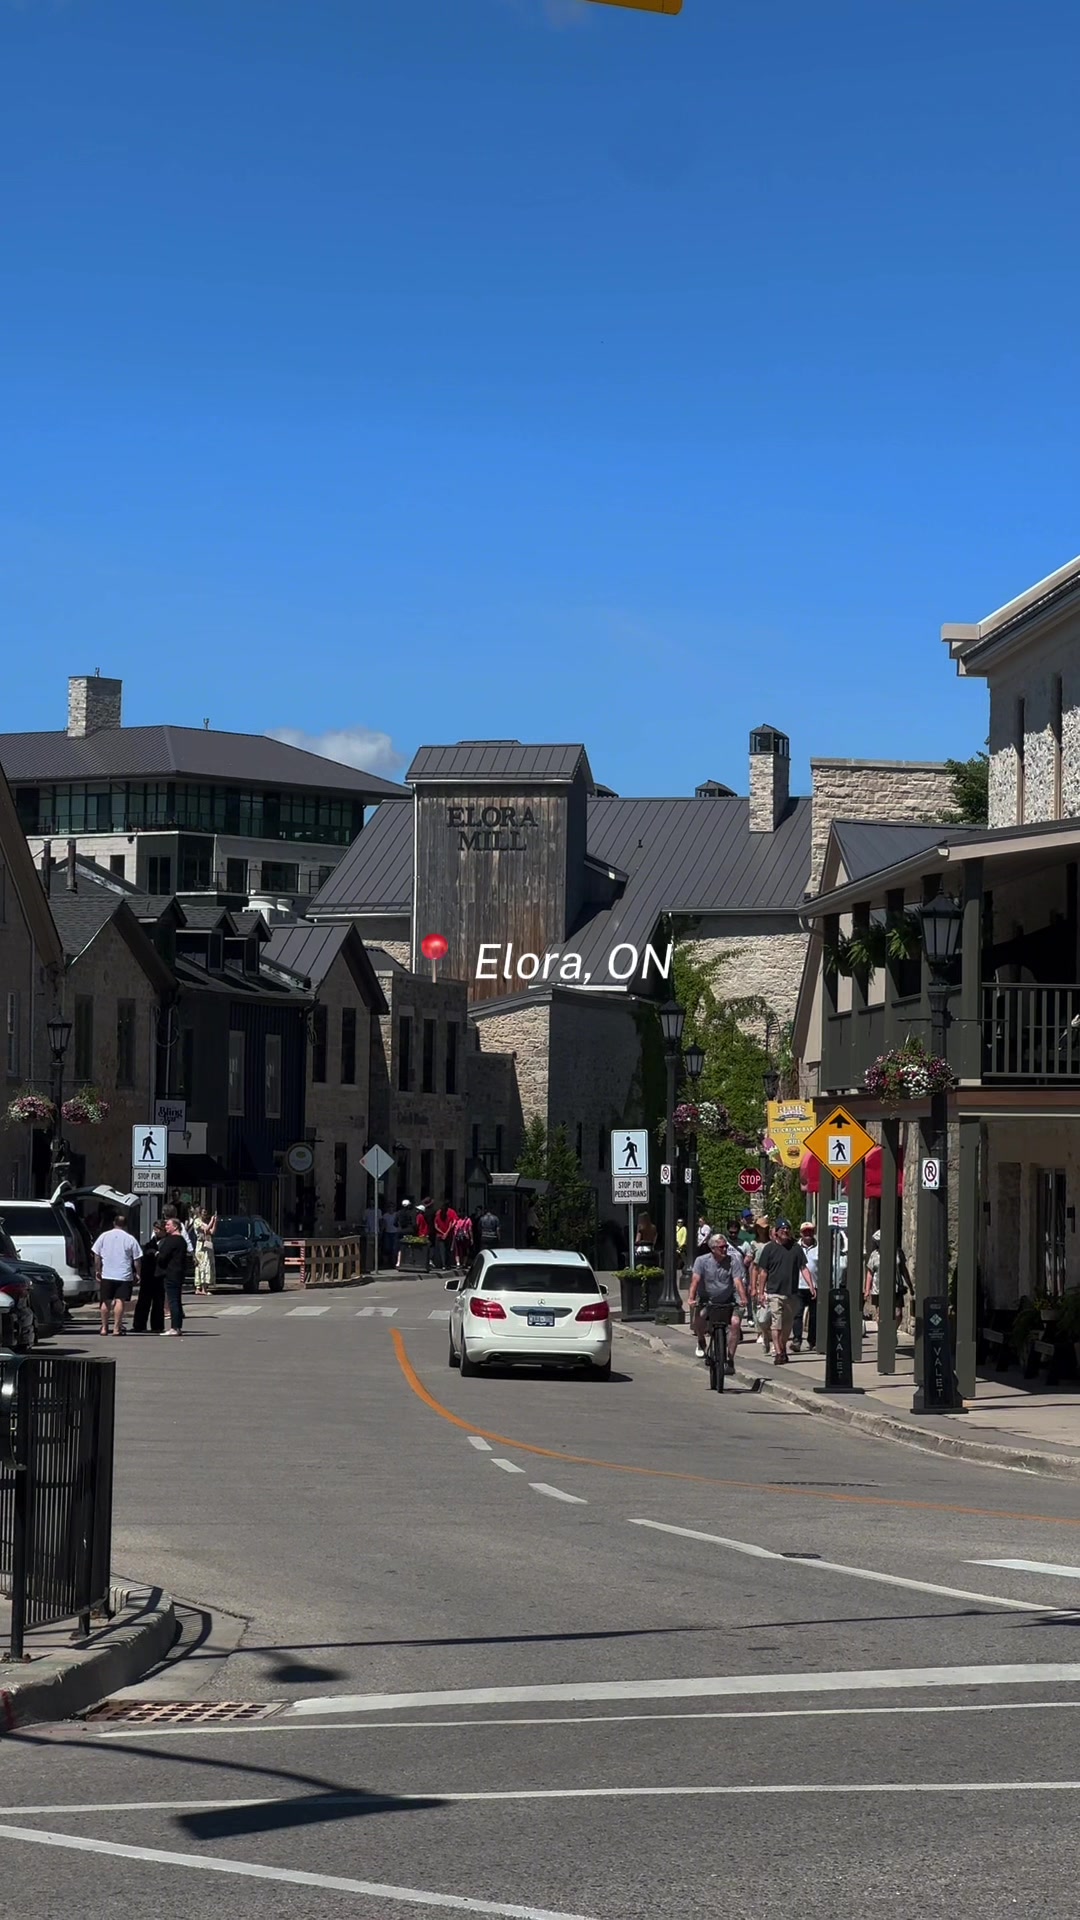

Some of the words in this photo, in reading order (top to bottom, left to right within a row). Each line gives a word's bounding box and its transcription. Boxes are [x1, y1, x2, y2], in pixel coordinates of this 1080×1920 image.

[446, 806, 539, 828] ELORA
[457, 830, 527, 851] MILL
[618, 1181, 631, 1189] STOP
[740, 1175, 761, 1185] STOP
[614, 1190, 647, 1198] PEDESTRIANS
[835, 1333, 844, 1379] VALET
[933, 1346, 943, 1398] VALET
